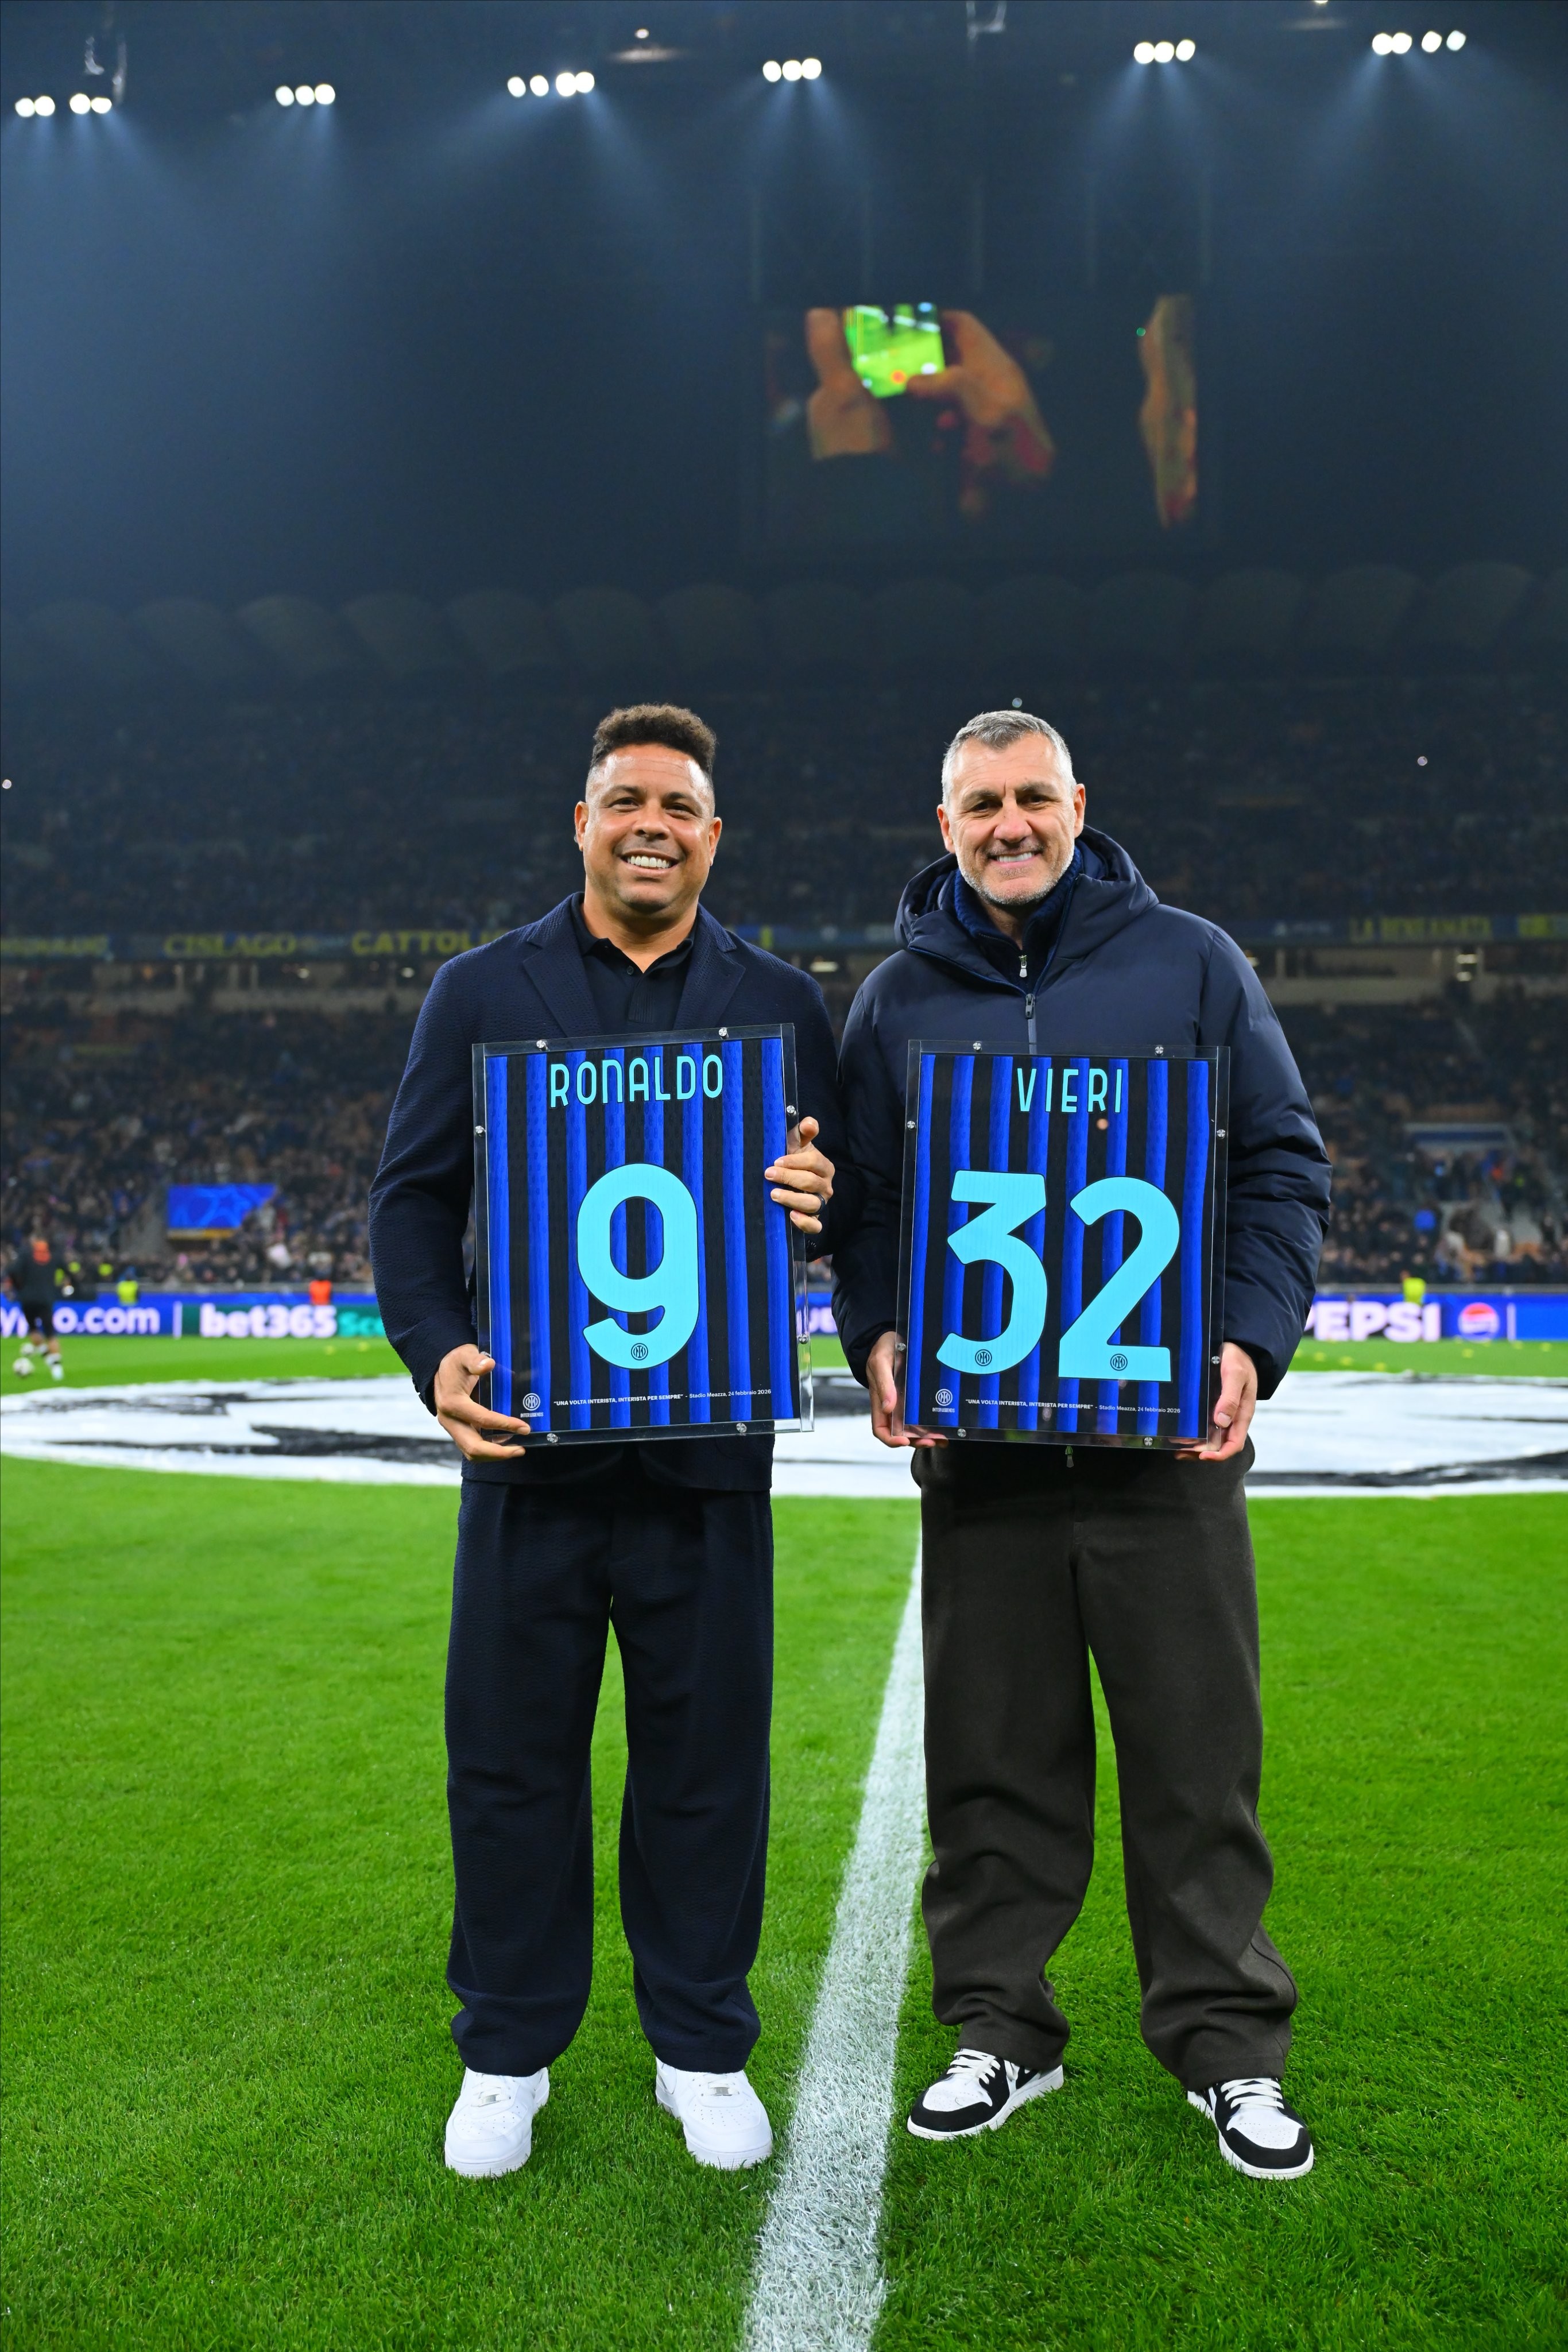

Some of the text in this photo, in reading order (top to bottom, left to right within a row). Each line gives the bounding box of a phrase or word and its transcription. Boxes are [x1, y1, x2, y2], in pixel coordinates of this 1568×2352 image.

[550, 1054, 723, 1108] RONALDO
[1017, 1068, 1122, 1113] VIERI
[577, 1163, 699, 1370] 9
[936, 1170, 1180, 1382] 32
[200, 1302, 338, 1338] bet365
